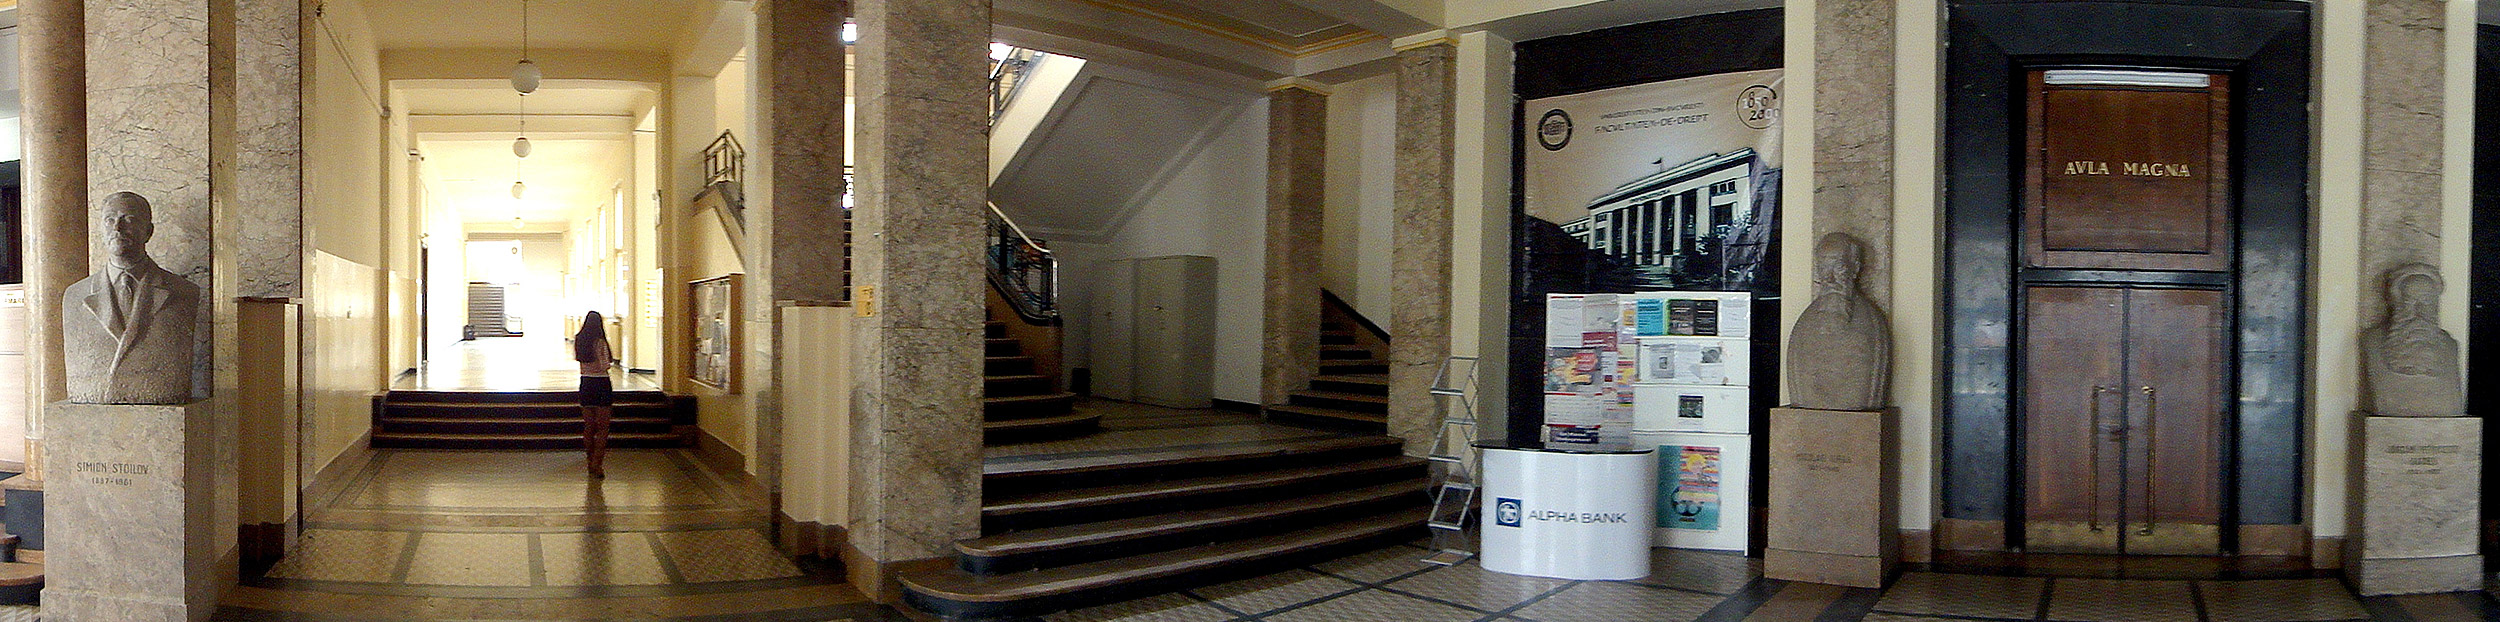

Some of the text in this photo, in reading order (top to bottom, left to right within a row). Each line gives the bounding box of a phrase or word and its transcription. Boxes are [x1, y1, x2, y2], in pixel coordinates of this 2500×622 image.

[2064, 160, 2191, 177] AVLA MAGNA
[76, 461, 108, 473] SIMION
[1527, 509, 1628, 525] ALPHA BANK
